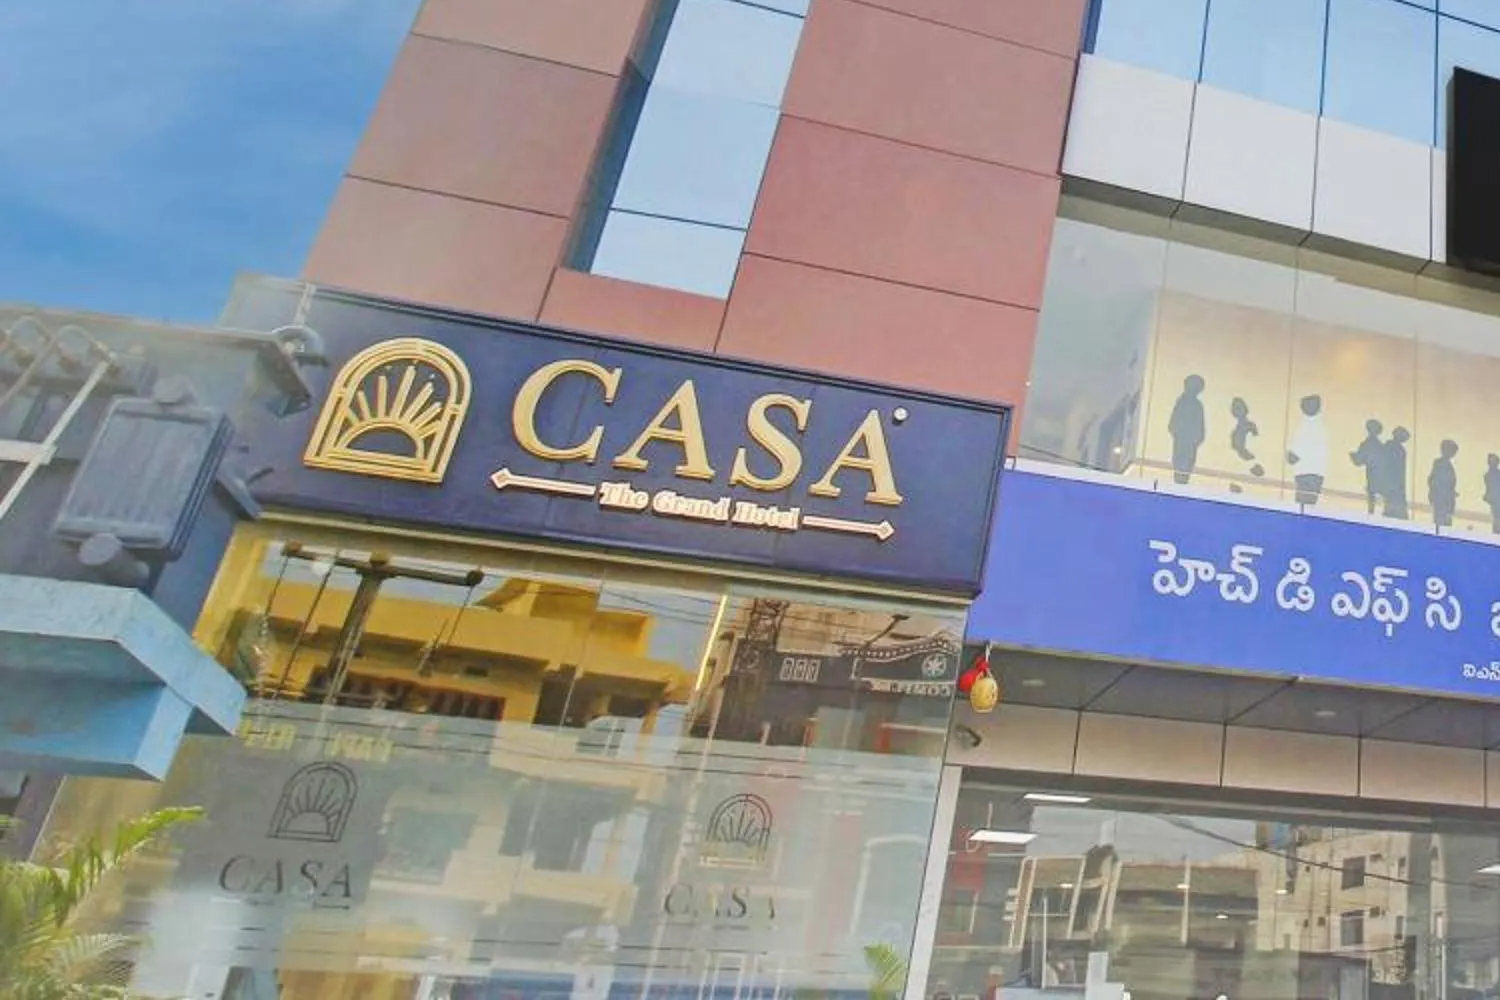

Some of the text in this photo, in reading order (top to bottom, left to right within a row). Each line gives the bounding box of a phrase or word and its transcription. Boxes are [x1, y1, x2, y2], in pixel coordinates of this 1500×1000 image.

[511, 359, 903, 505] CASA
[599, 481, 801, 530] The Grand Hotel
[1148, 539, 1264, 604] హెచ్
[1275, 556, 1316, 612] డి
[1330, 564, 1409, 637] ఎఫ్
[1424, 576, 1462, 632] సి
[217, 854, 352, 898] CASA
